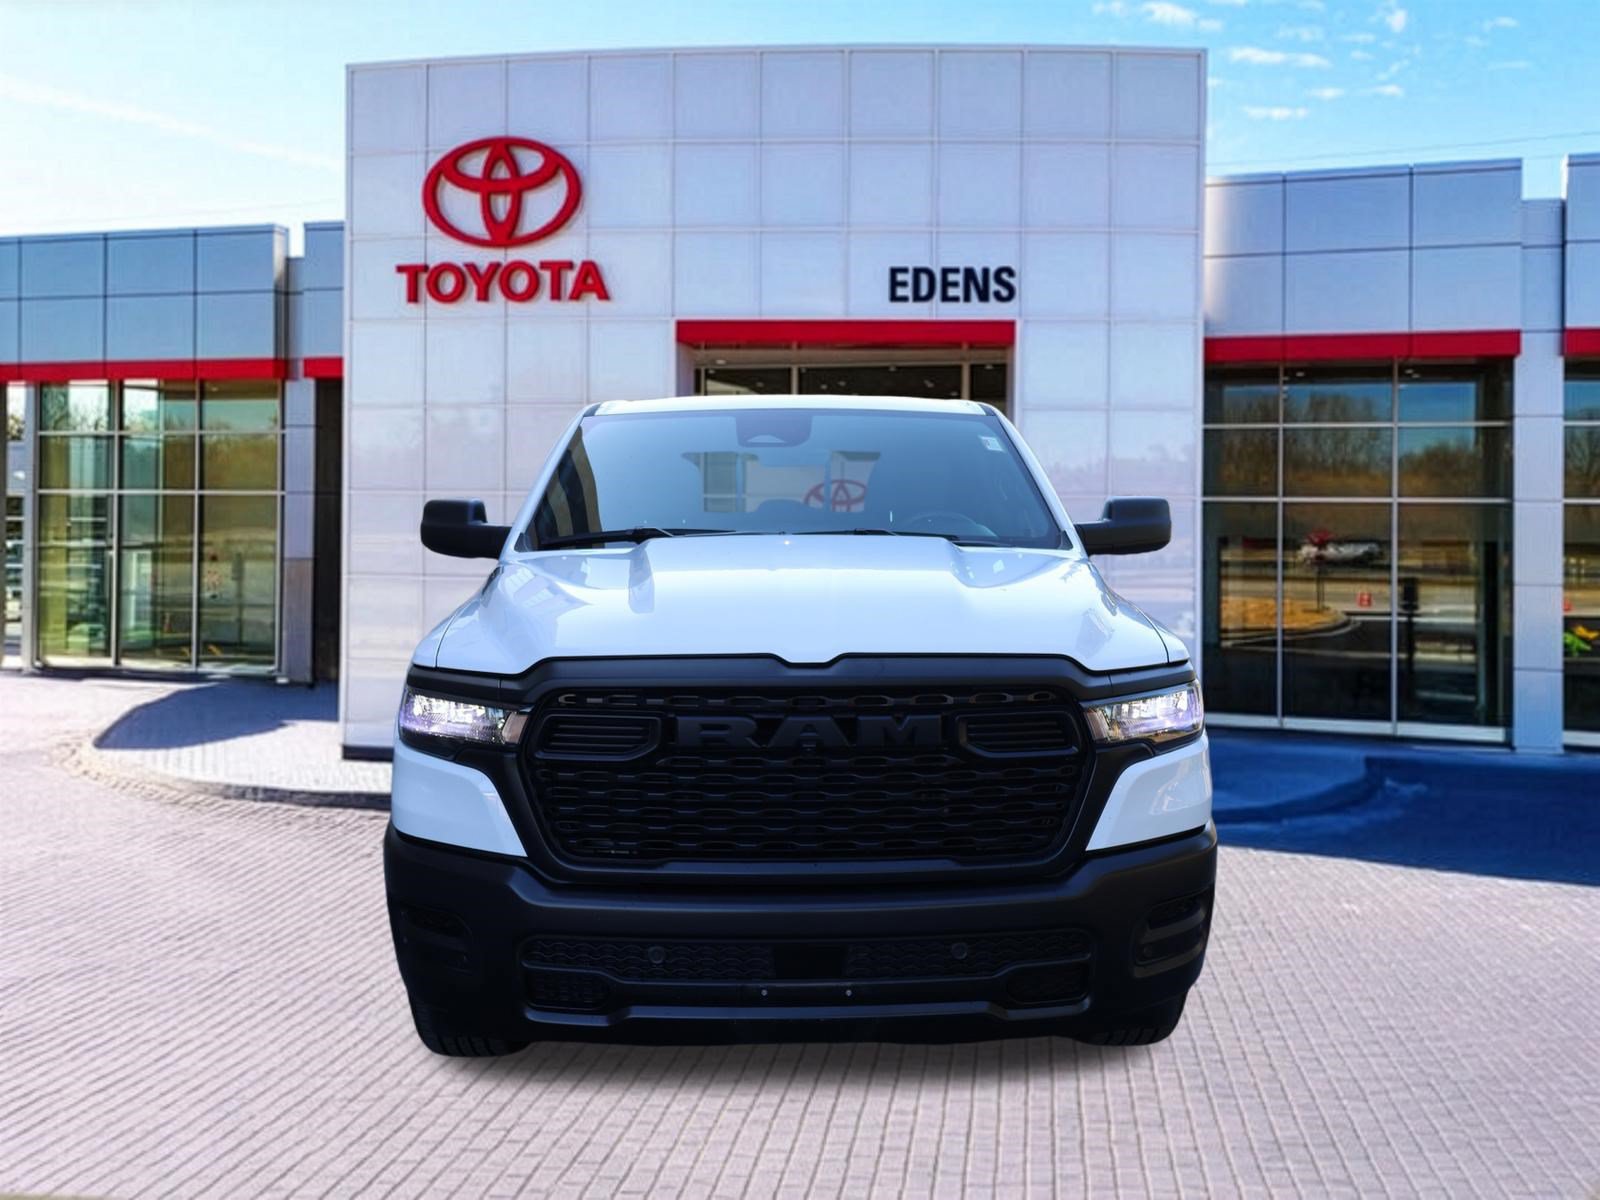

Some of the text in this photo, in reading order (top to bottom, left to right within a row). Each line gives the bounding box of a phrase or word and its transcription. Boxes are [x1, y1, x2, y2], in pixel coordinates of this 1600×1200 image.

[396, 260, 610, 303] TOYOTA
[889, 266, 1016, 302] EDENS
[676, 715, 942, 748] RAM
